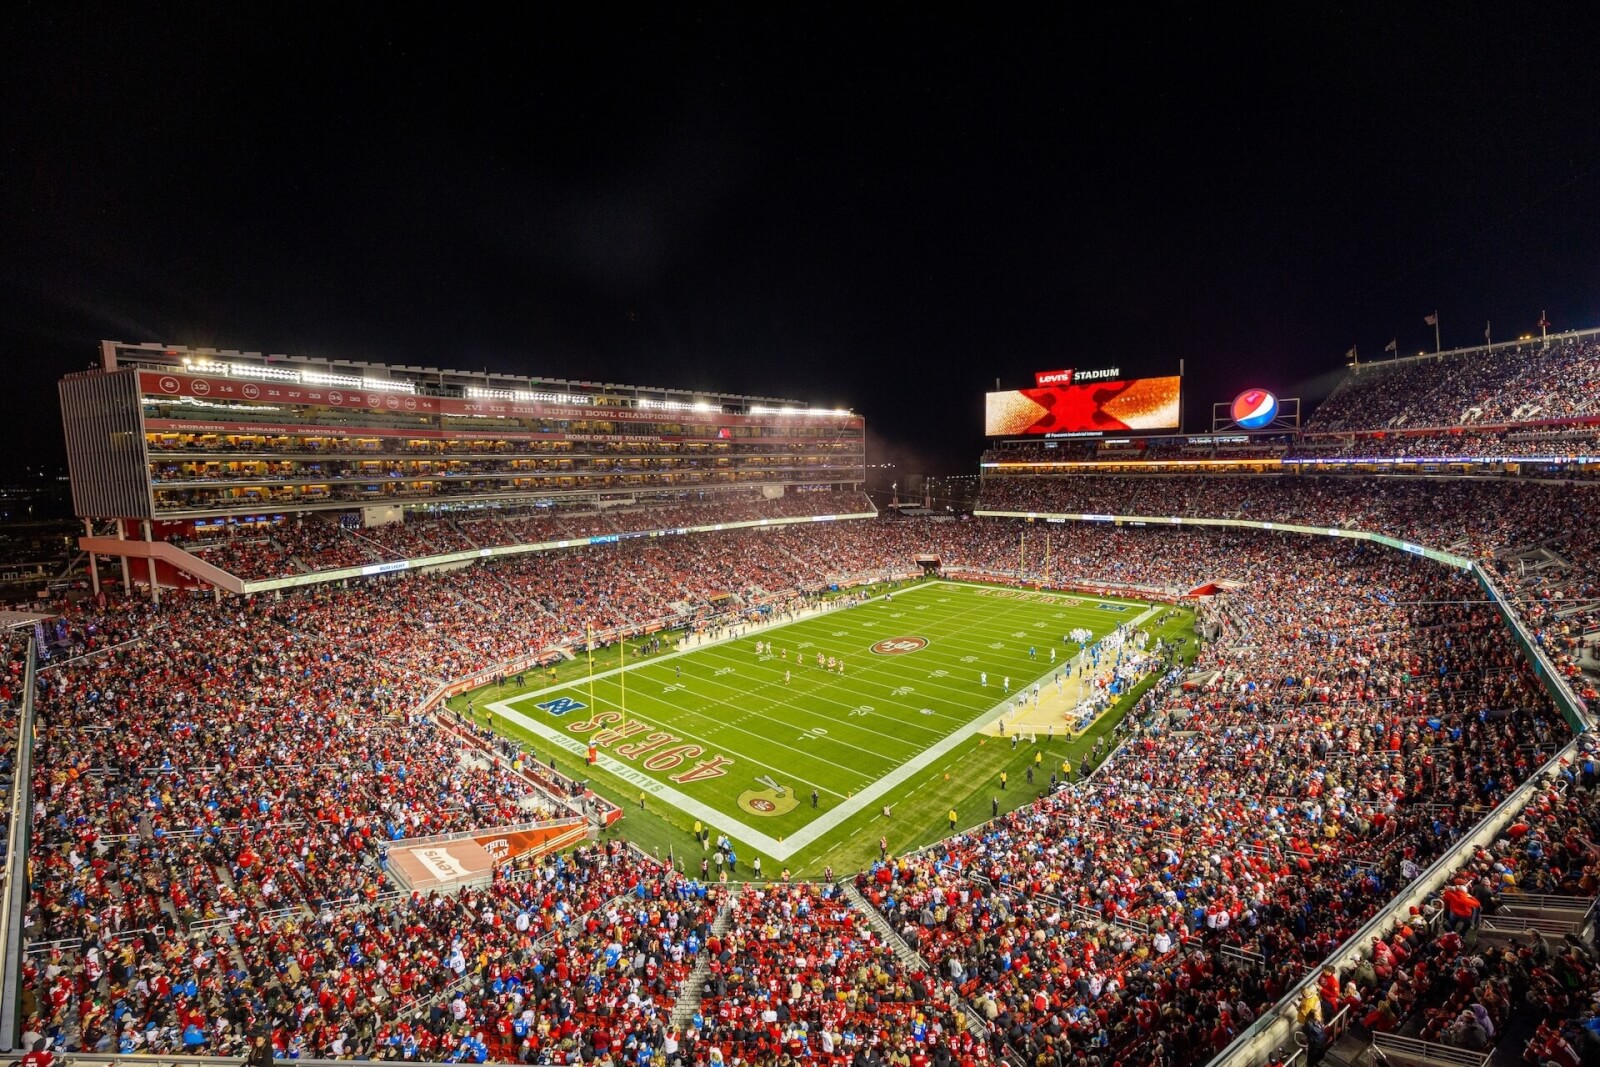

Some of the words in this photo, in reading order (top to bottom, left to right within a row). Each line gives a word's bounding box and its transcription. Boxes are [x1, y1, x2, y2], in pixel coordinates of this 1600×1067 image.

[1074, 368, 1119, 380] STADIUM
[194, 383, 208, 391] 12
[543, 407, 582, 416] SUPER
[585, 410, 617, 418] BOWL
[618, 412, 676, 420] CHAMPIONS
[512, 662, 526, 672] THE
[549, 734, 587, 755] ERVICE
